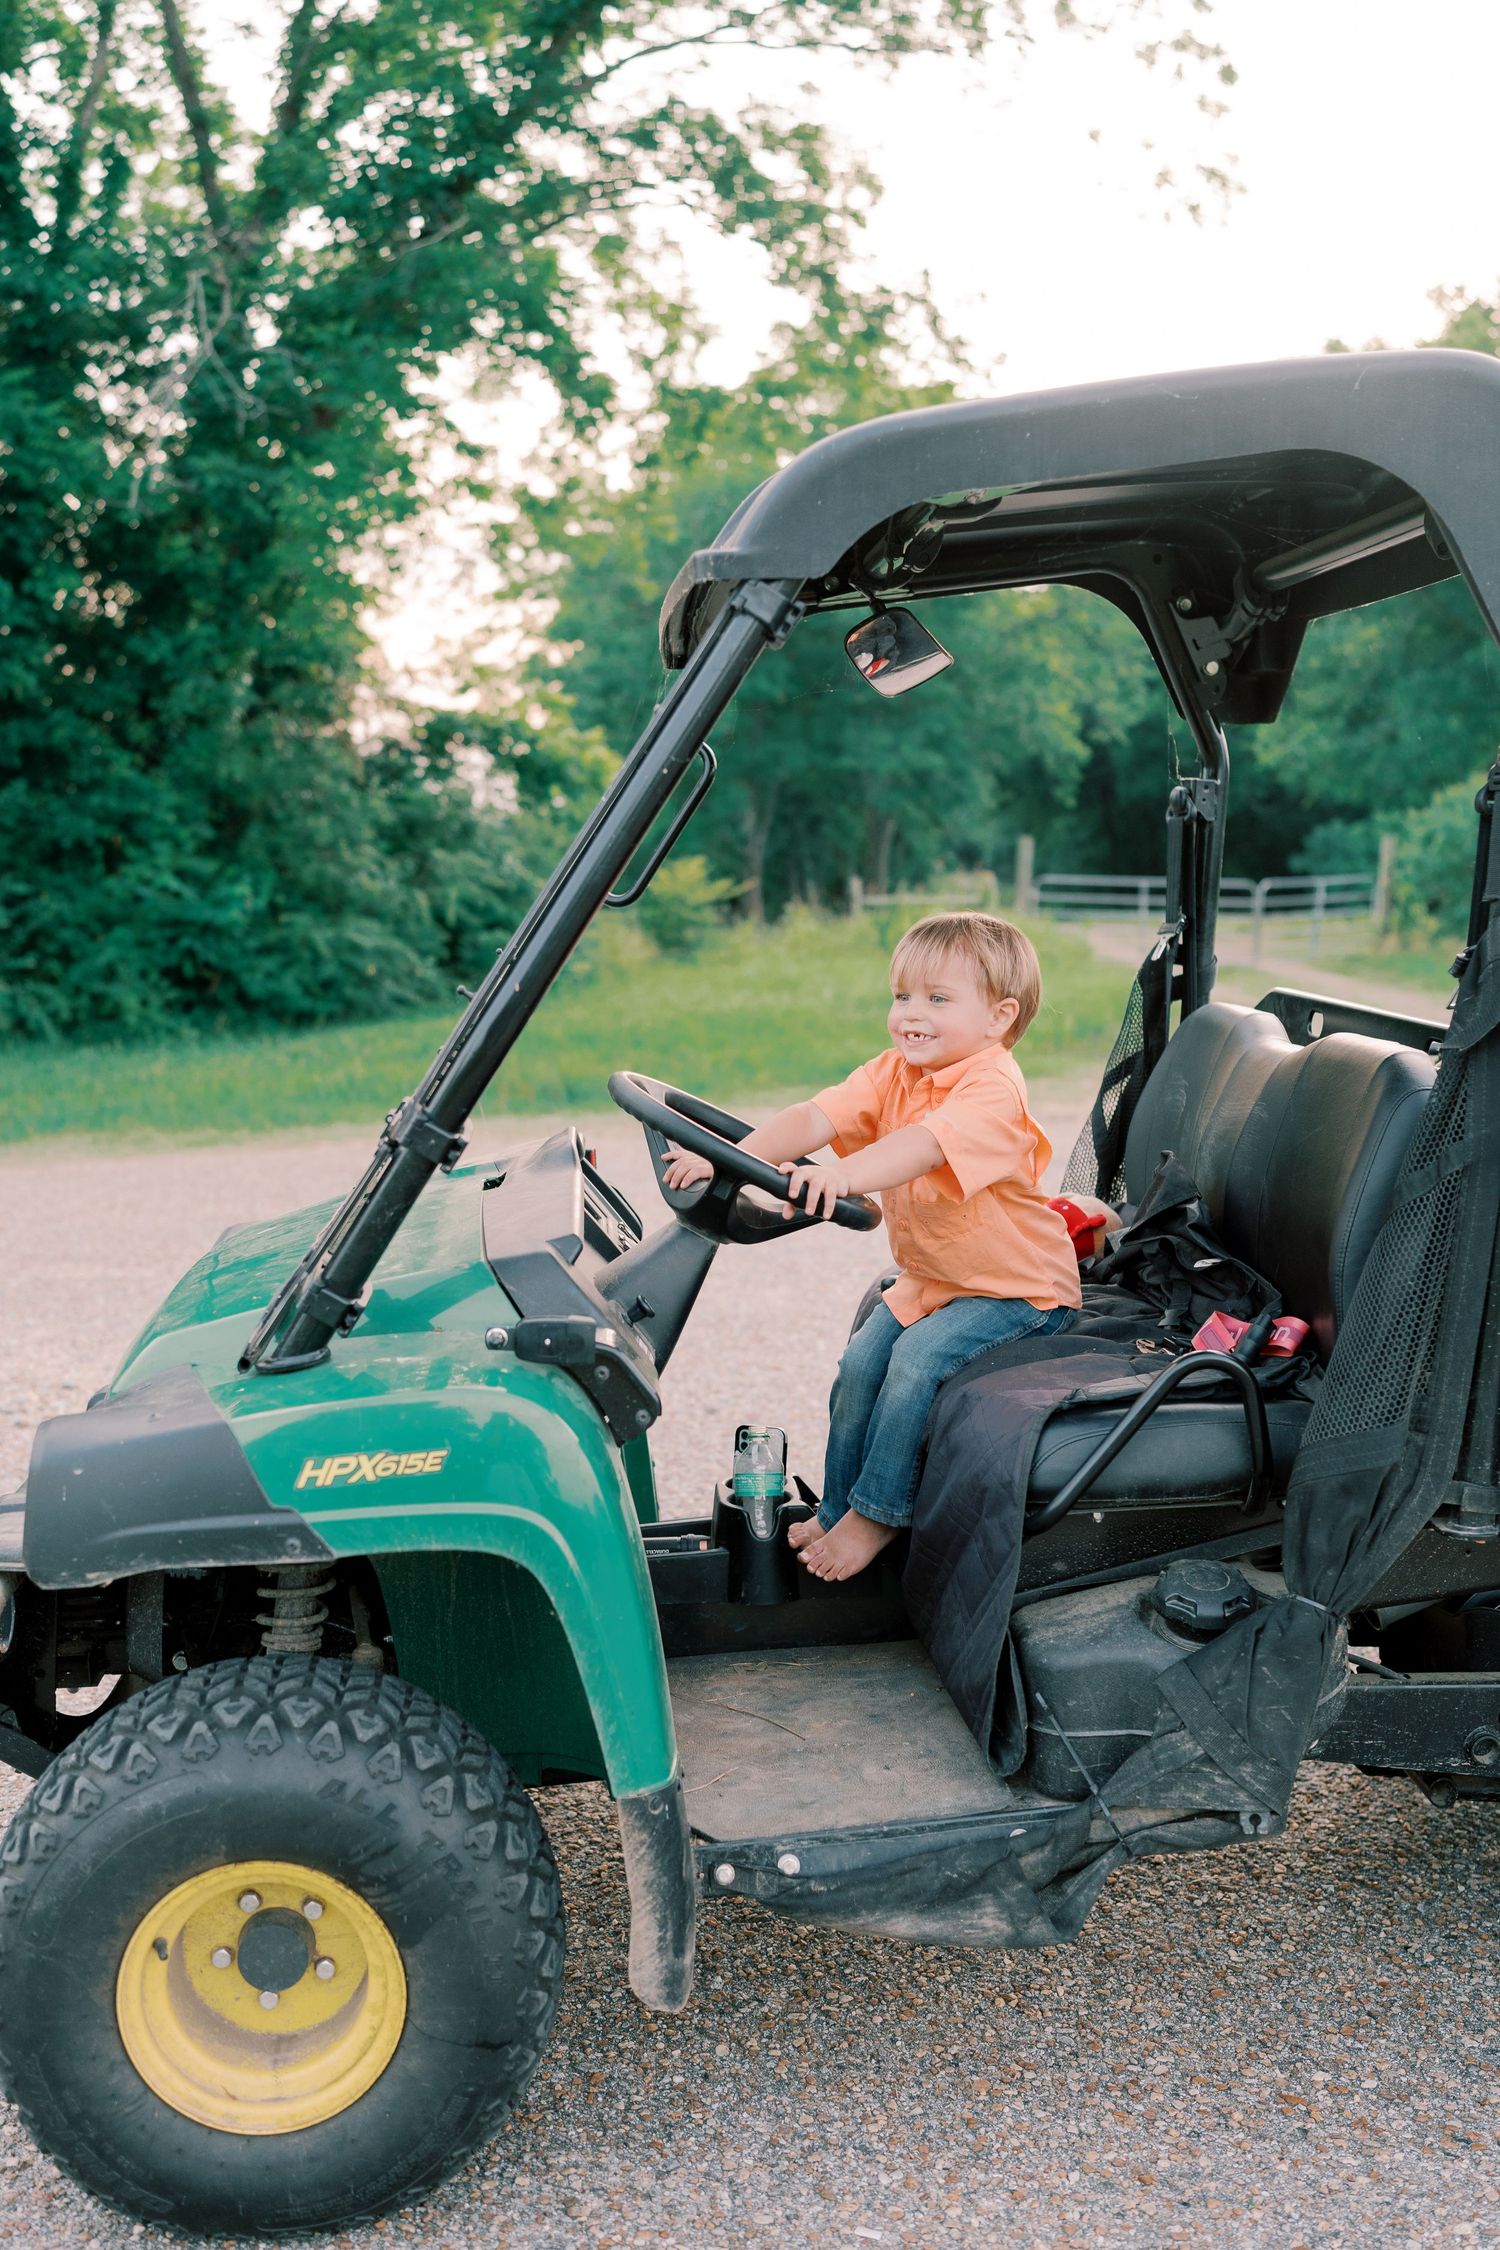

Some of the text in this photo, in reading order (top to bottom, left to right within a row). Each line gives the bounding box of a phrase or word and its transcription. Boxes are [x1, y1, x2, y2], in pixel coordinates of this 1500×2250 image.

[296, 1449, 449, 1489] HPX615E
[317, 1779, 399, 1830] ALL
[416, 1831, 494, 1944] TRAIL
